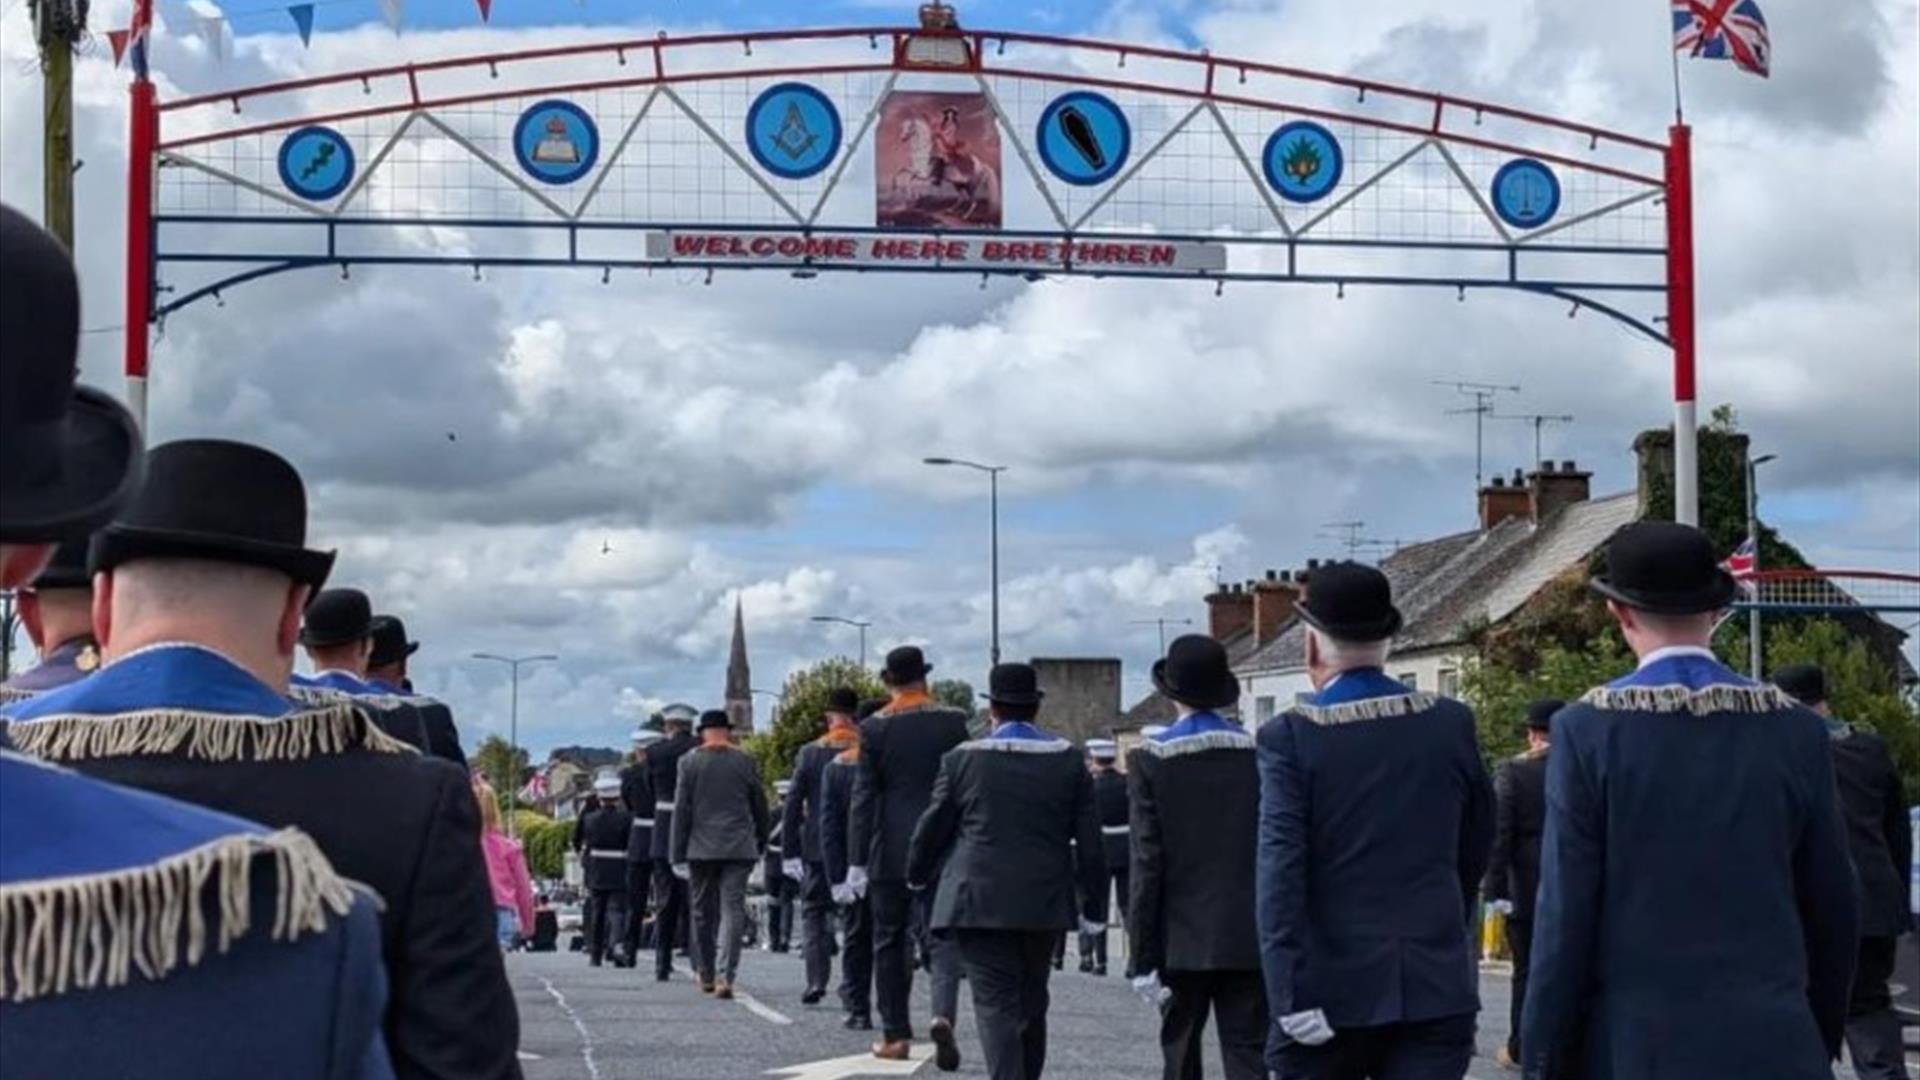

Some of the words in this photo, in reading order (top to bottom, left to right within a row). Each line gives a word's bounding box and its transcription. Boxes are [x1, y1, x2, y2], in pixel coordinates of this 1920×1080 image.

[674, 236, 857, 258] WELCOME
[871, 239, 967, 261] HERE
[982, 242, 1176, 265] BRETHREN
